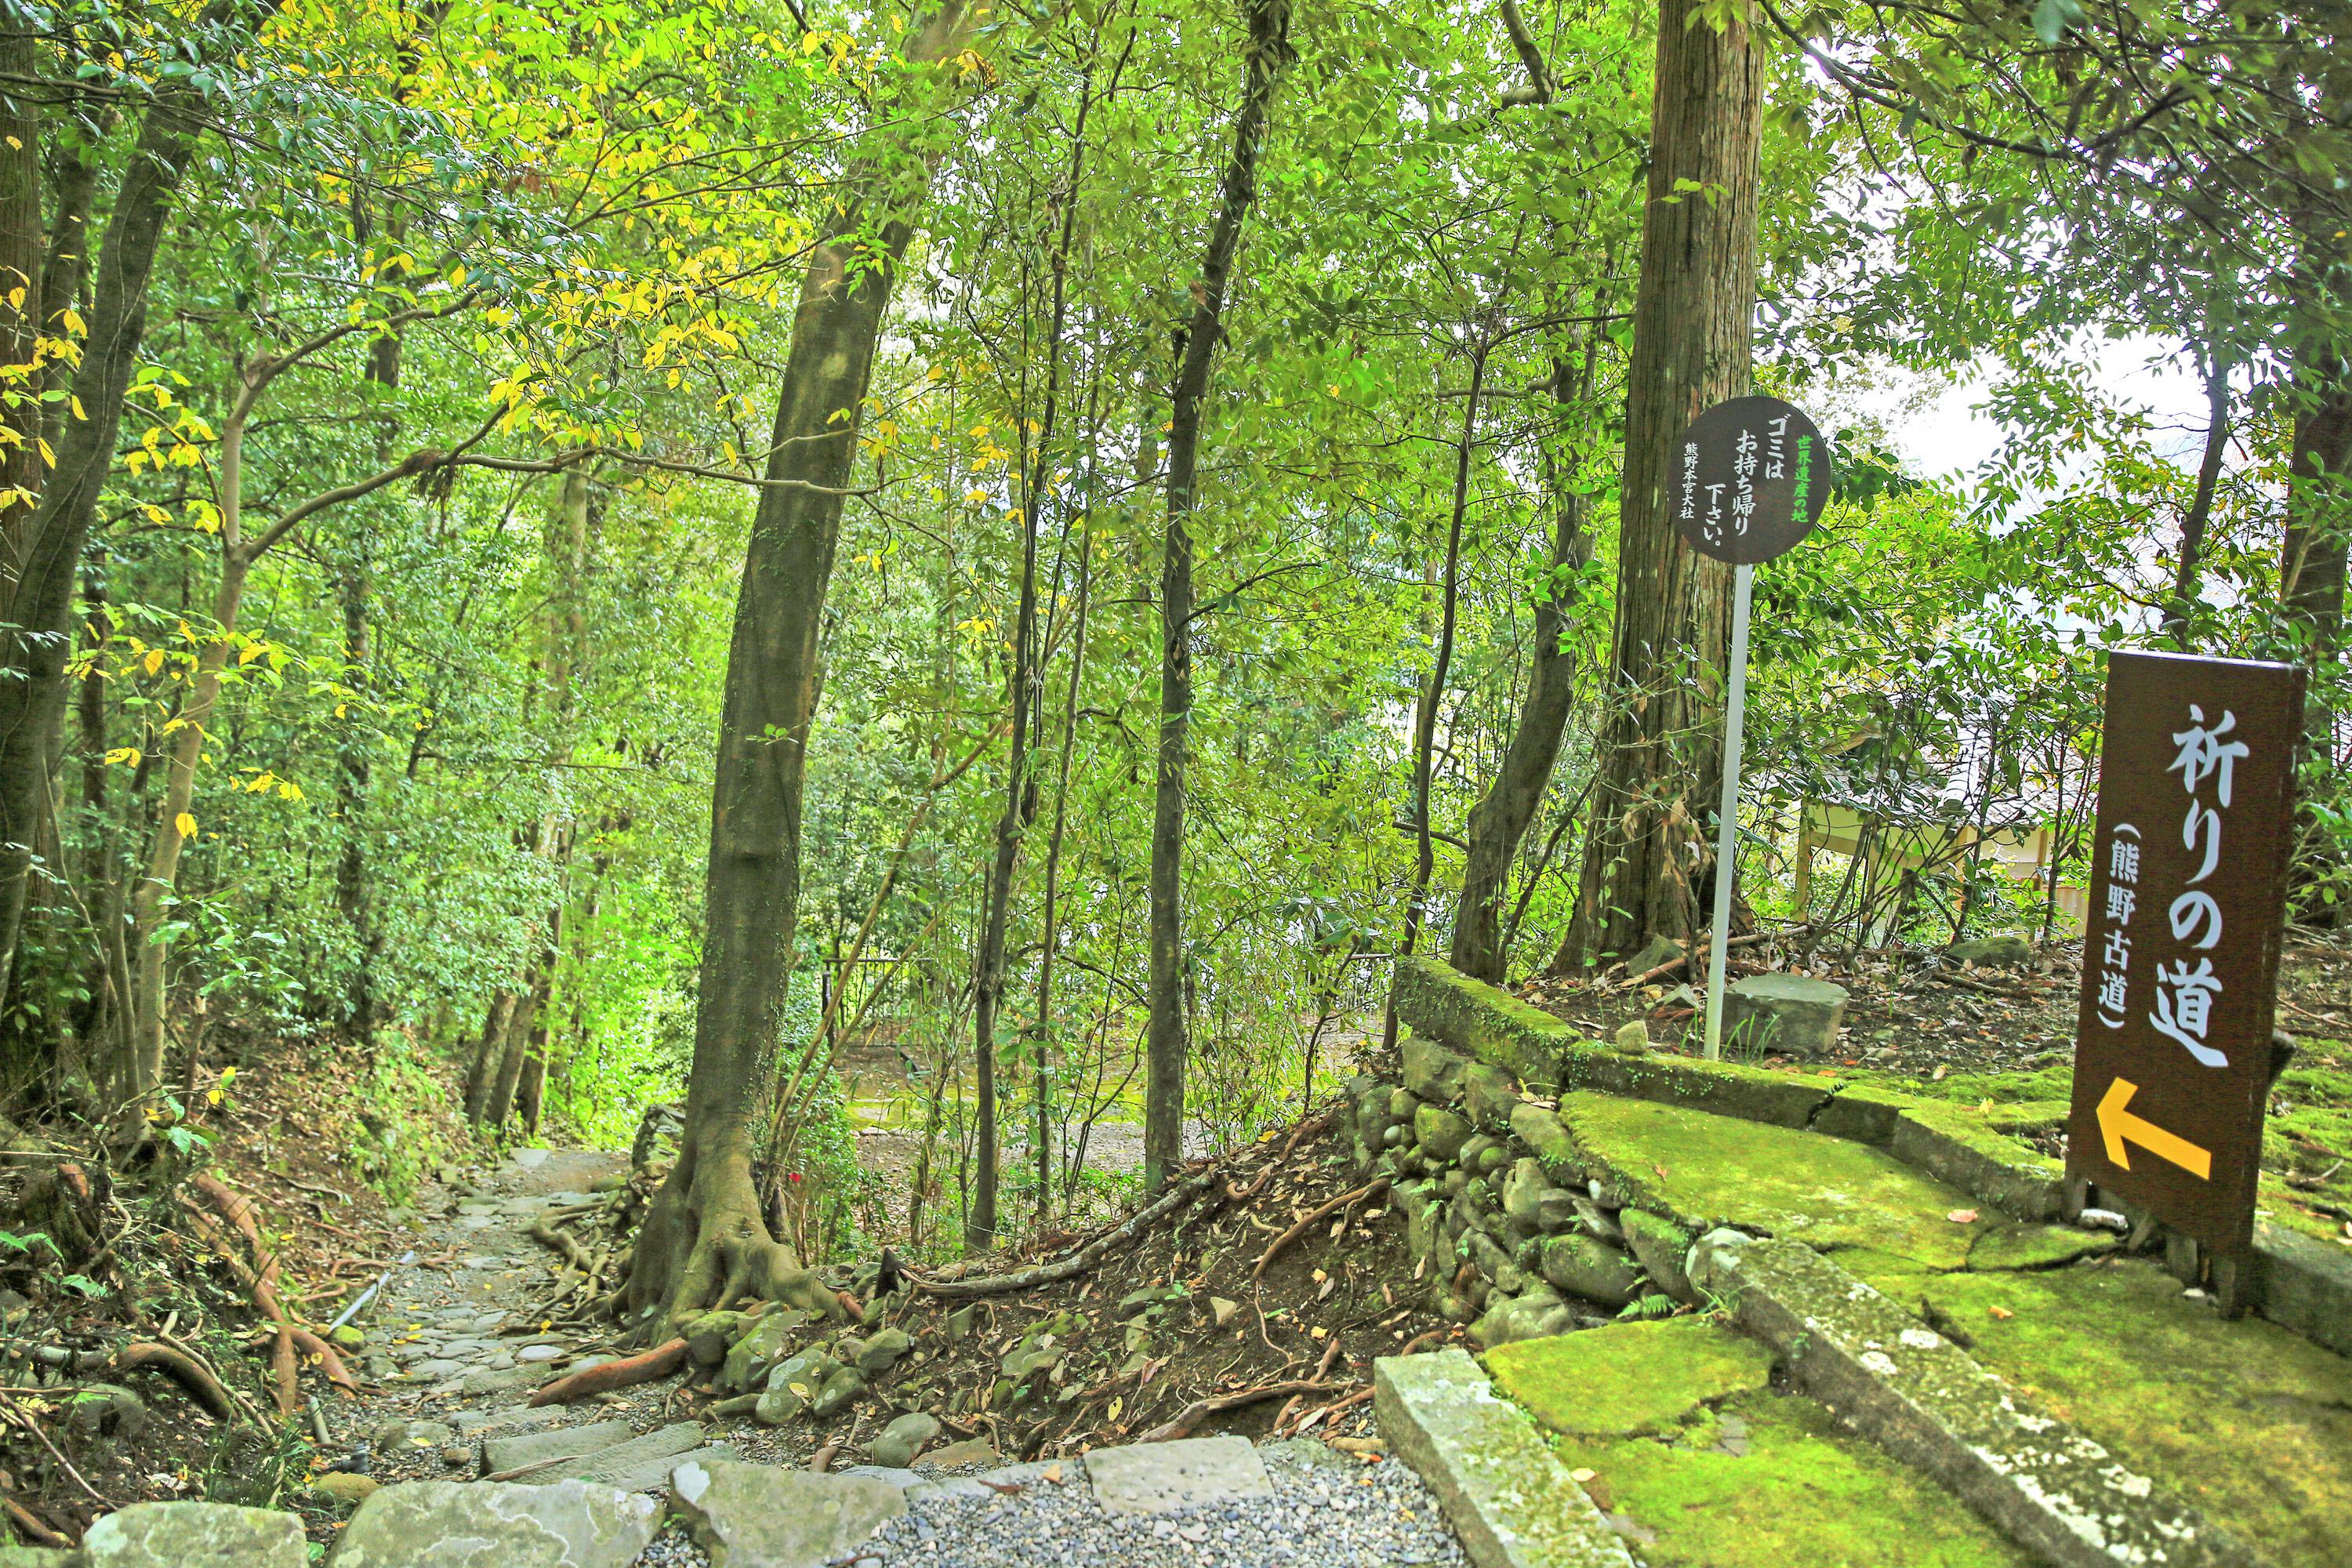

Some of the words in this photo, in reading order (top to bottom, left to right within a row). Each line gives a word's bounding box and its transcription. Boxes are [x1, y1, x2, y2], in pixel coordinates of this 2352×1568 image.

[1679, 442, 1699, 519] 熊野本宮大社
[1732, 430, 1759, 535] お持ち帰り
[1765, 413, 1791, 479] ゴミは
[1703, 483, 1726, 546] 下さい。
[2149, 704, 2250, 1068] 祈りの道
